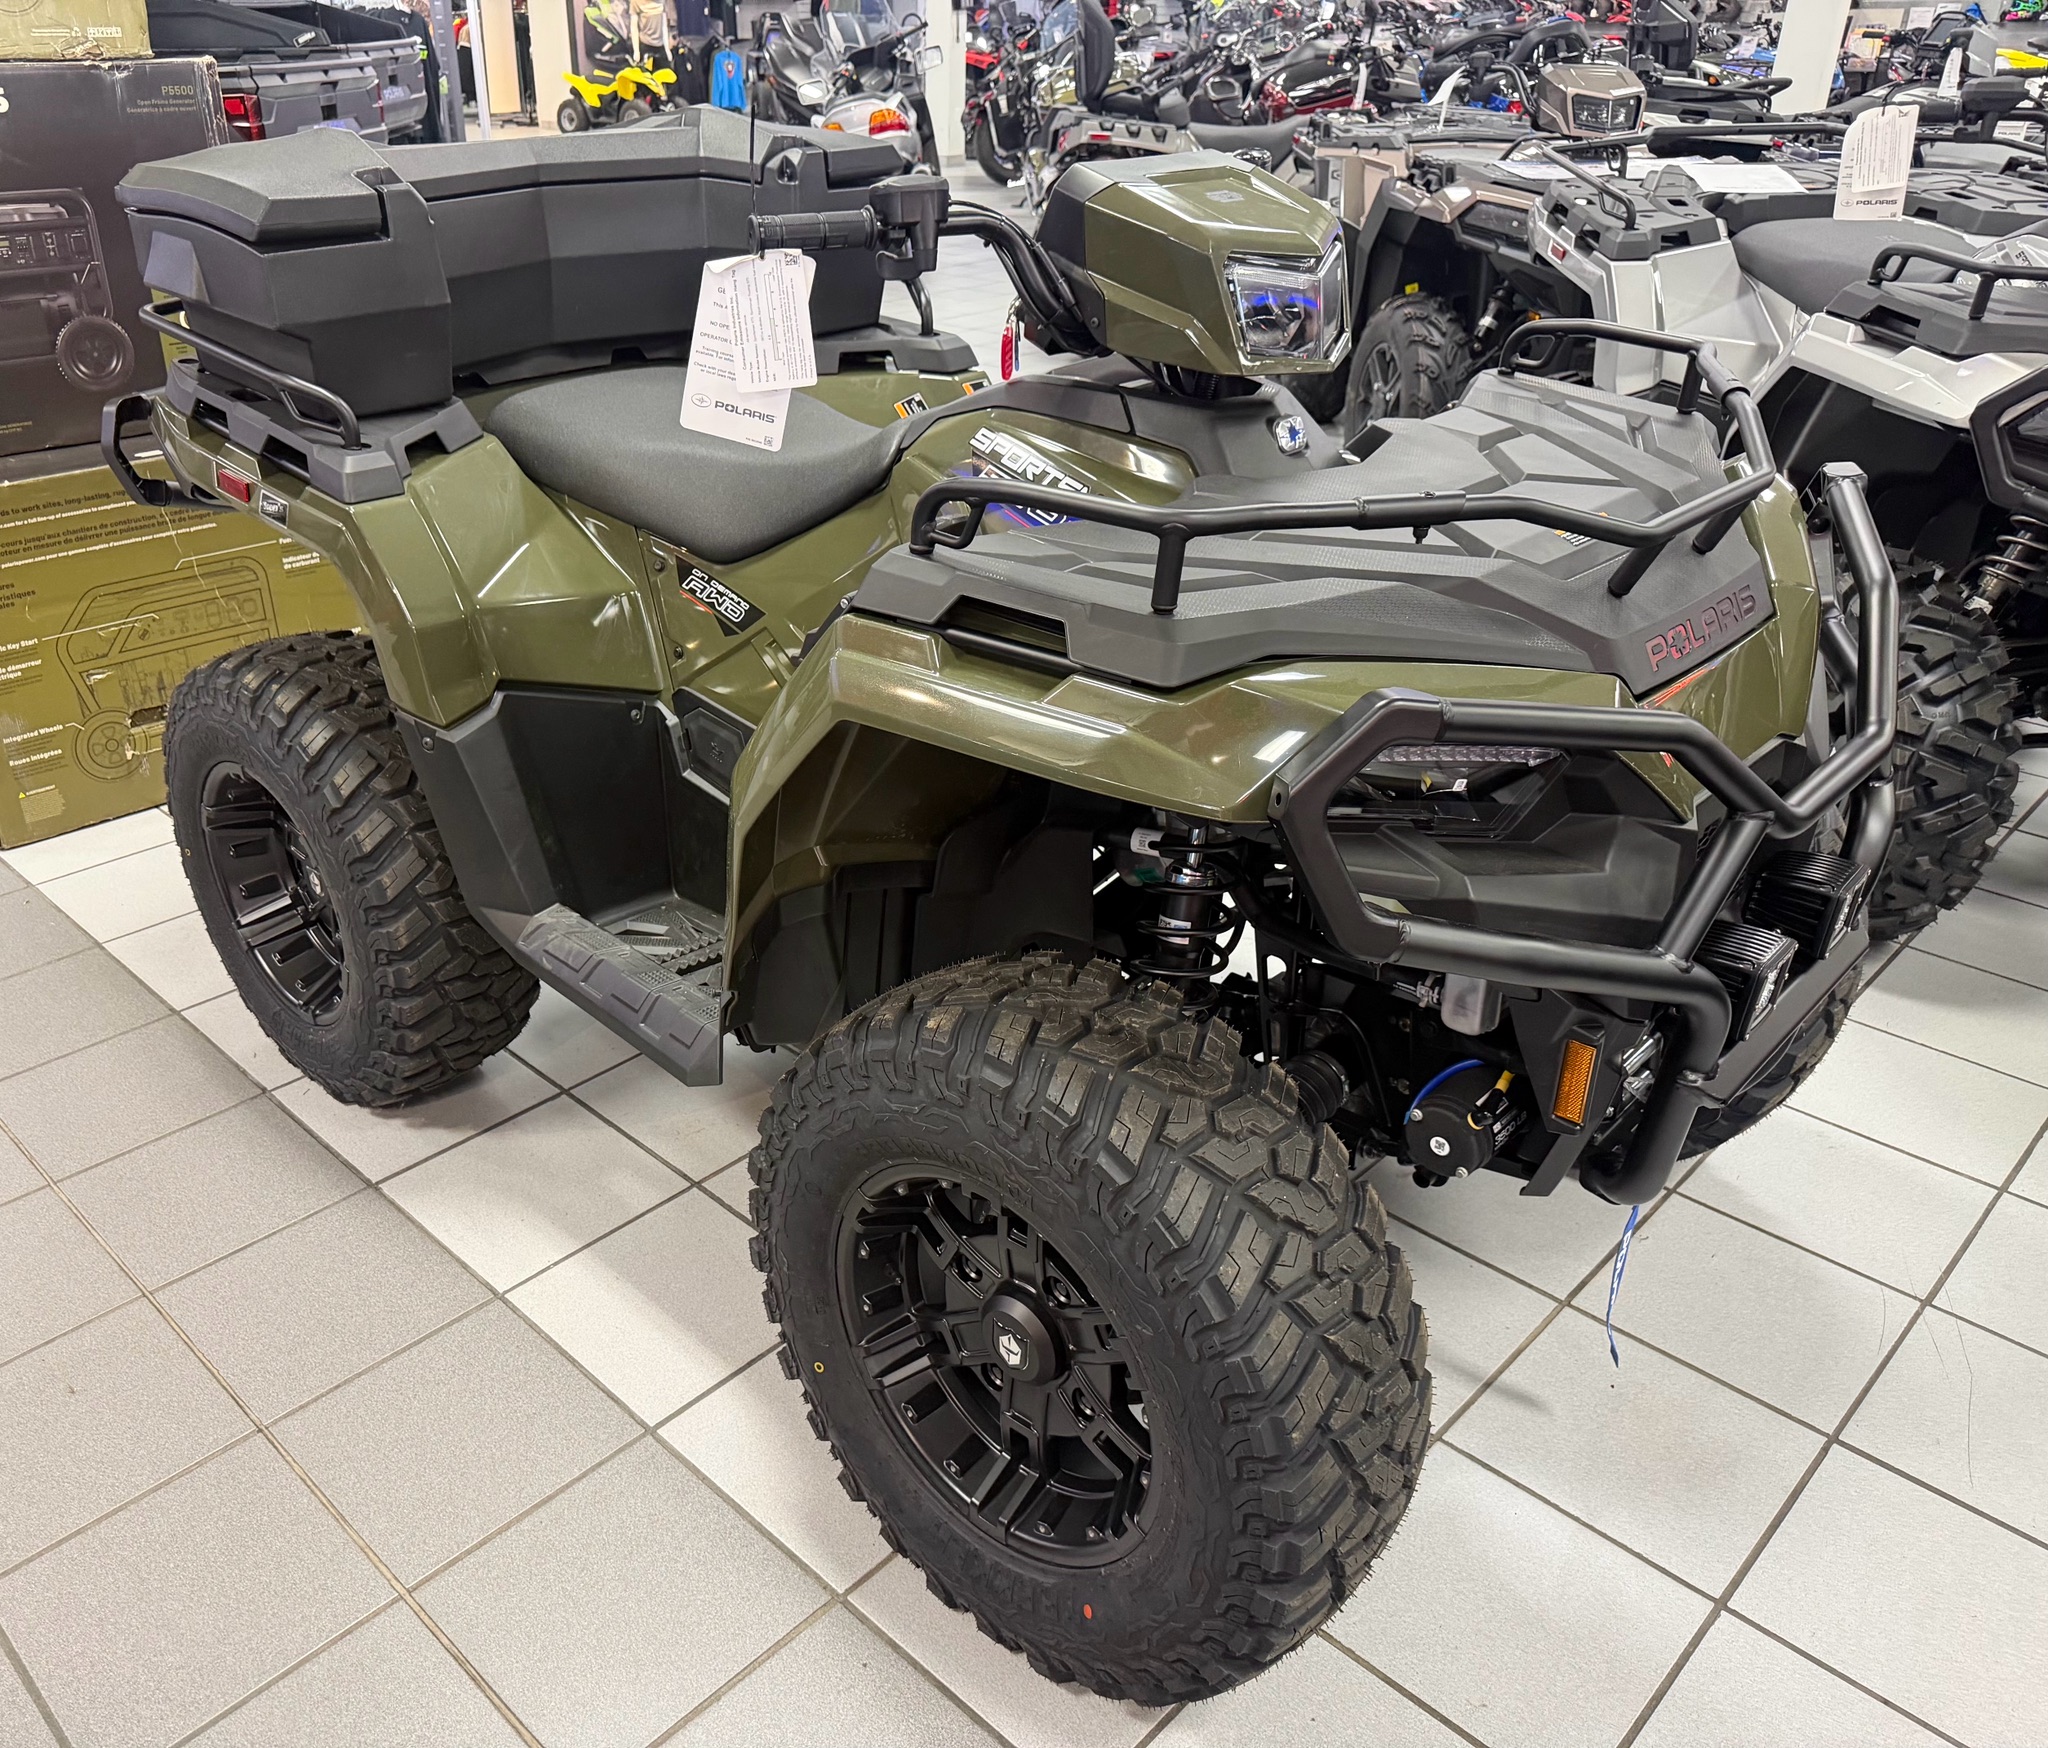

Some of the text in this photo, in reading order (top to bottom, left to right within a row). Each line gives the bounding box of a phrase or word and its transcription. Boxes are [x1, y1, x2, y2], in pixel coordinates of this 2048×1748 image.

[161, 85, 194, 96] P5500
[169, 97, 196, 105] Generator
[699, 331, 729, 343] OPERATOR
[714, 400, 776, 424] POLARIS
[969, 426, 1091, 494] SPORTS
[21, 503, 40, 513] work
[41, 499, 63, 509] sites,
[64, 490, 112, 506] long-lasting,
[33, 539, 63, 550] mesure
[118, 521, 155, 534] puissance
[61, 523, 98, 536] chantiers
[109, 512, 157, 528] construction,
[681, 575, 745, 622] AWD
[1644, 584, 1757, 672] POLARIS
[7, 641, 20, 651] Key
[20, 638, 38, 647] Start
[3, 723, 64, 744] Integrated Wheels
[9, 757, 31, 767] Roues
